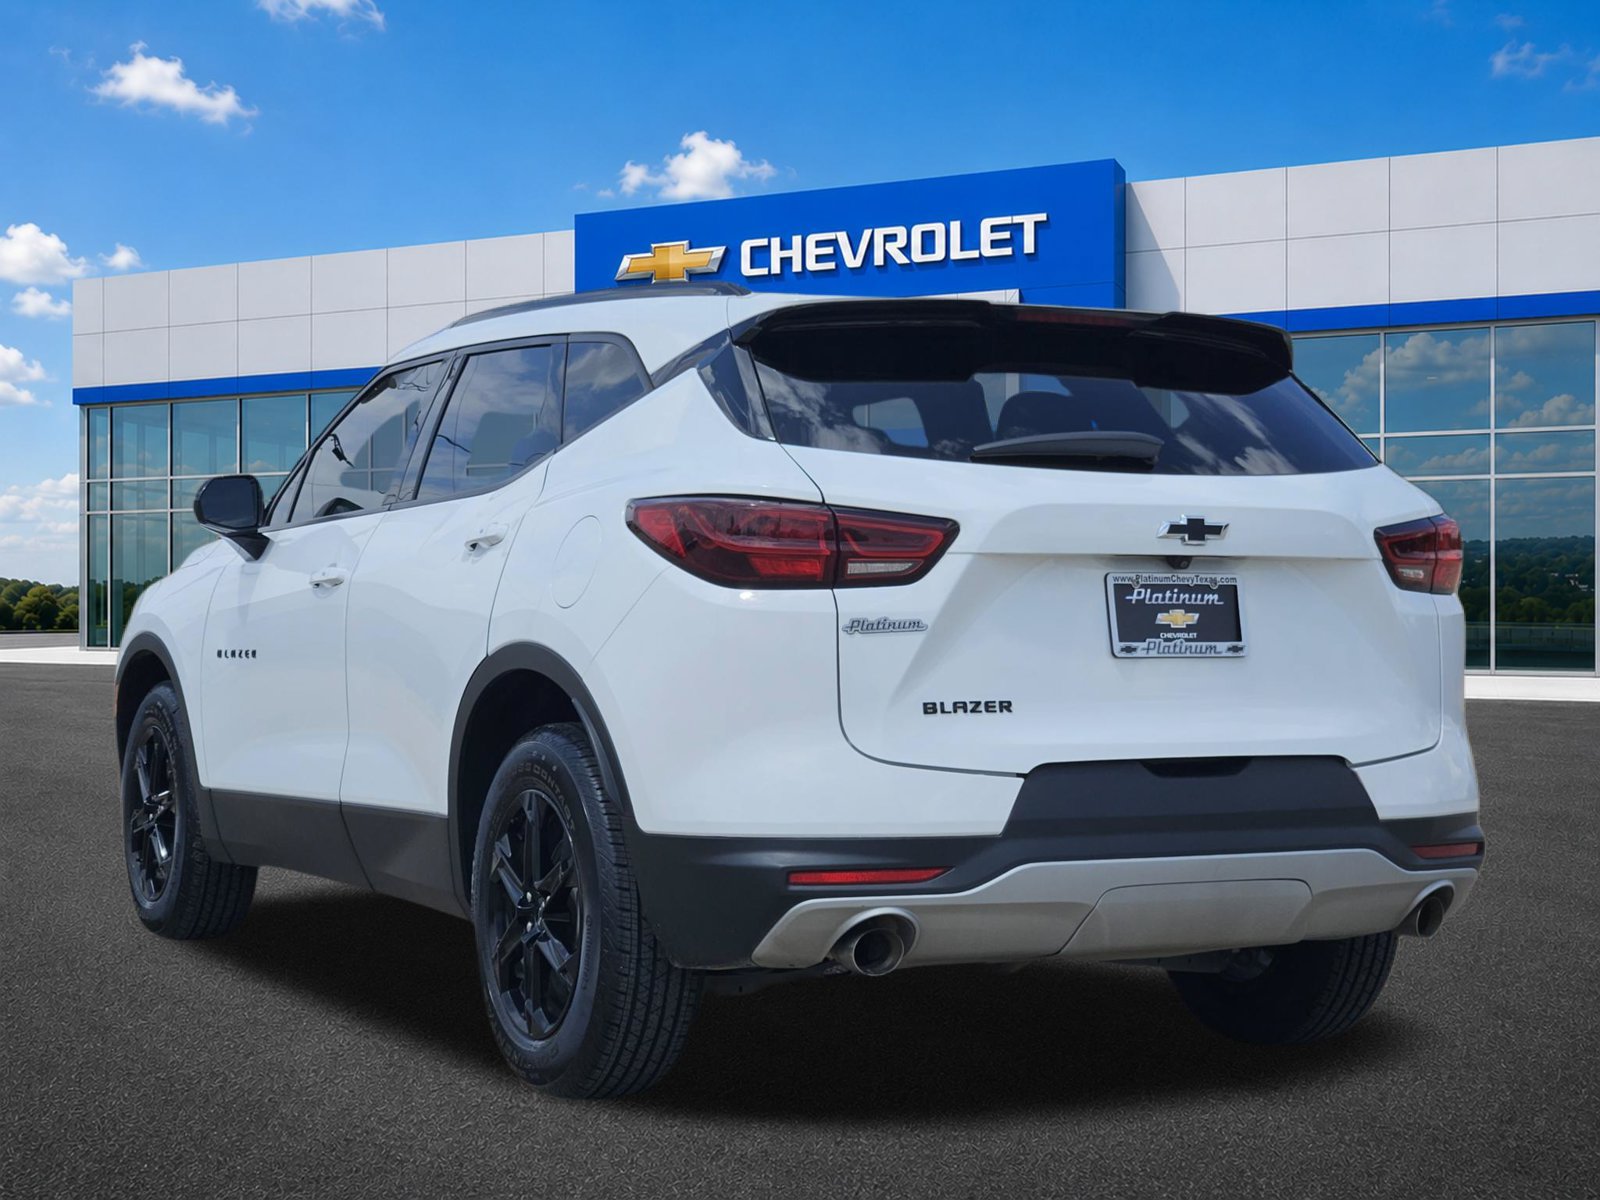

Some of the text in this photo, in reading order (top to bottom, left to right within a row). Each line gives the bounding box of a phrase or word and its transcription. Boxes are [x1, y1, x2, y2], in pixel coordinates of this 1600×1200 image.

[741, 213, 1047, 277] CHEVROLET
[1112, 574, 1238, 586] www.PlatinumChevyTexas.com
[1125, 588, 1224, 604] Platinum
[843, 617, 928, 635] Platinum
[216, 649, 257, 659] BLAZER
[1145, 639, 1223, 655] Platinum
[922, 700, 1013, 715] BLAZER
